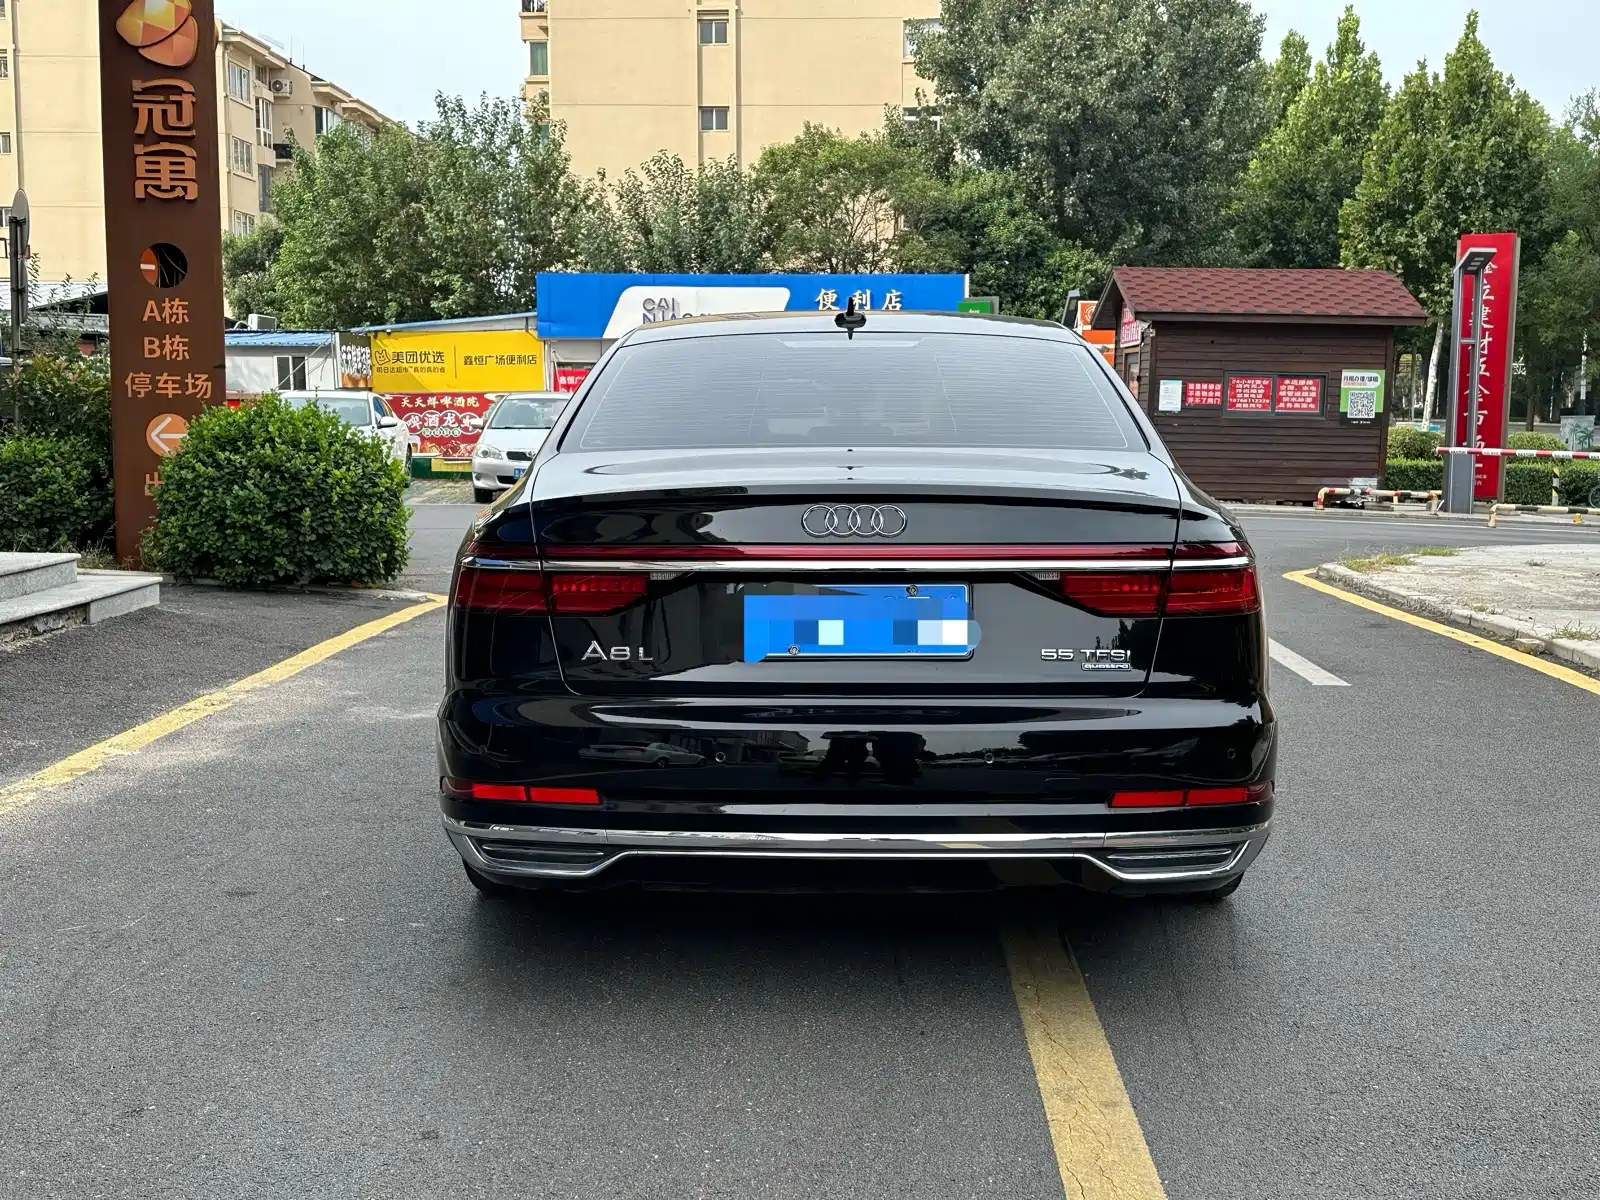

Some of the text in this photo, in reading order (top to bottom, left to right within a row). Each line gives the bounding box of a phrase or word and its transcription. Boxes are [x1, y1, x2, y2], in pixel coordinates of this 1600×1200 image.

[131, 78, 198, 200] 冠寓
[642, 297, 675, 312] CAI
[815, 289, 903, 311] 便利店
[143, 298, 189, 324] A栋
[143, 335, 190, 361] B栋
[391, 350, 445, 364] 美团优选
[463, 354, 538, 366] 鑫恒广场便利店
[124, 372, 212, 399] 停车场
[580, 640, 653, 661] A8 L
[1041, 648, 1131, 661] 55 TFSI
